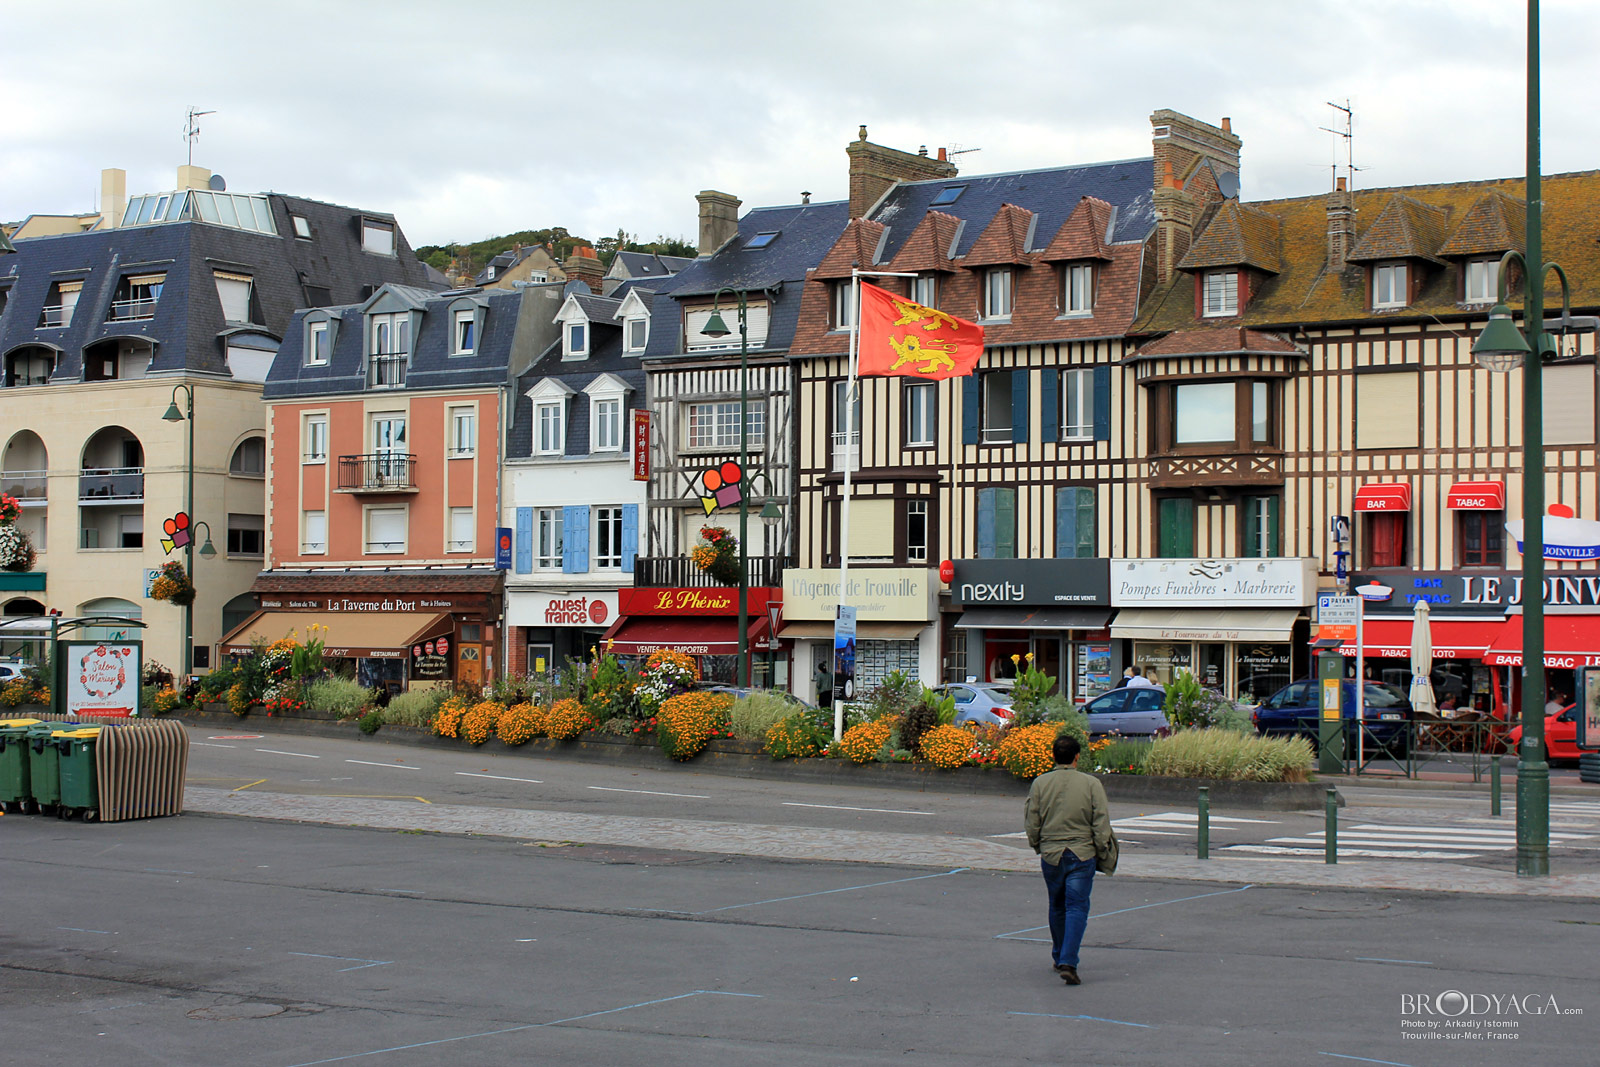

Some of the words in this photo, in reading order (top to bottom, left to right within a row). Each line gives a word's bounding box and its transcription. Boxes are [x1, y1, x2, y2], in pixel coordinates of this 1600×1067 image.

[1367, 500, 1386, 508] BAR
[1456, 498, 1486, 507] TABAC
[1544, 547, 1595, 557] JOINVILLE
[846, 579, 861, 597] de
[865, 578, 917, 597] Trouville
[1413, 578, 1443, 588] BAR
[961, 580, 1025, 601] nexity
[1120, 581, 1161, 599] Pompes
[1165, 580, 1216, 595] Funèbres
[1233, 580, 1296, 595] Marbrerie
[1461, 576, 1502, 604] LE
[1508, 576, 1600, 605] JINV
[549, 597, 587, 611] ouest
[654, 591, 673, 609] Le
[676, 590, 731, 609] Phénix
[1405, 594, 1451, 603] TABAC
[327, 599, 339, 611] La
[342, 599, 380, 611] Taverne
[381, 599, 393, 611] du
[395, 599, 416, 611] Port
[545, 609, 587, 624] france
[1161, 630, 1169, 638] Le
[1173, 630, 1208, 639] Tourneurs
[1213, 631, 1222, 639] du
[1226, 631, 1239, 639] Val
[637, 645, 660, 654] VENTES
[673, 646, 708, 654] EMPORTER
[1339, 648, 1356, 656] BAR
[1380, 649, 1408, 657] TABAC
[1432, 650, 1456, 658] LOTO
[1146, 655, 1171, 663] Tourneurs
[1172, 655, 1179, 663] du
[1180, 655, 1190, 663] Val
[1496, 655, 1522, 664] BAR
[1543, 657, 1575, 668] BAC
[1327, 661, 1336, 672] P
